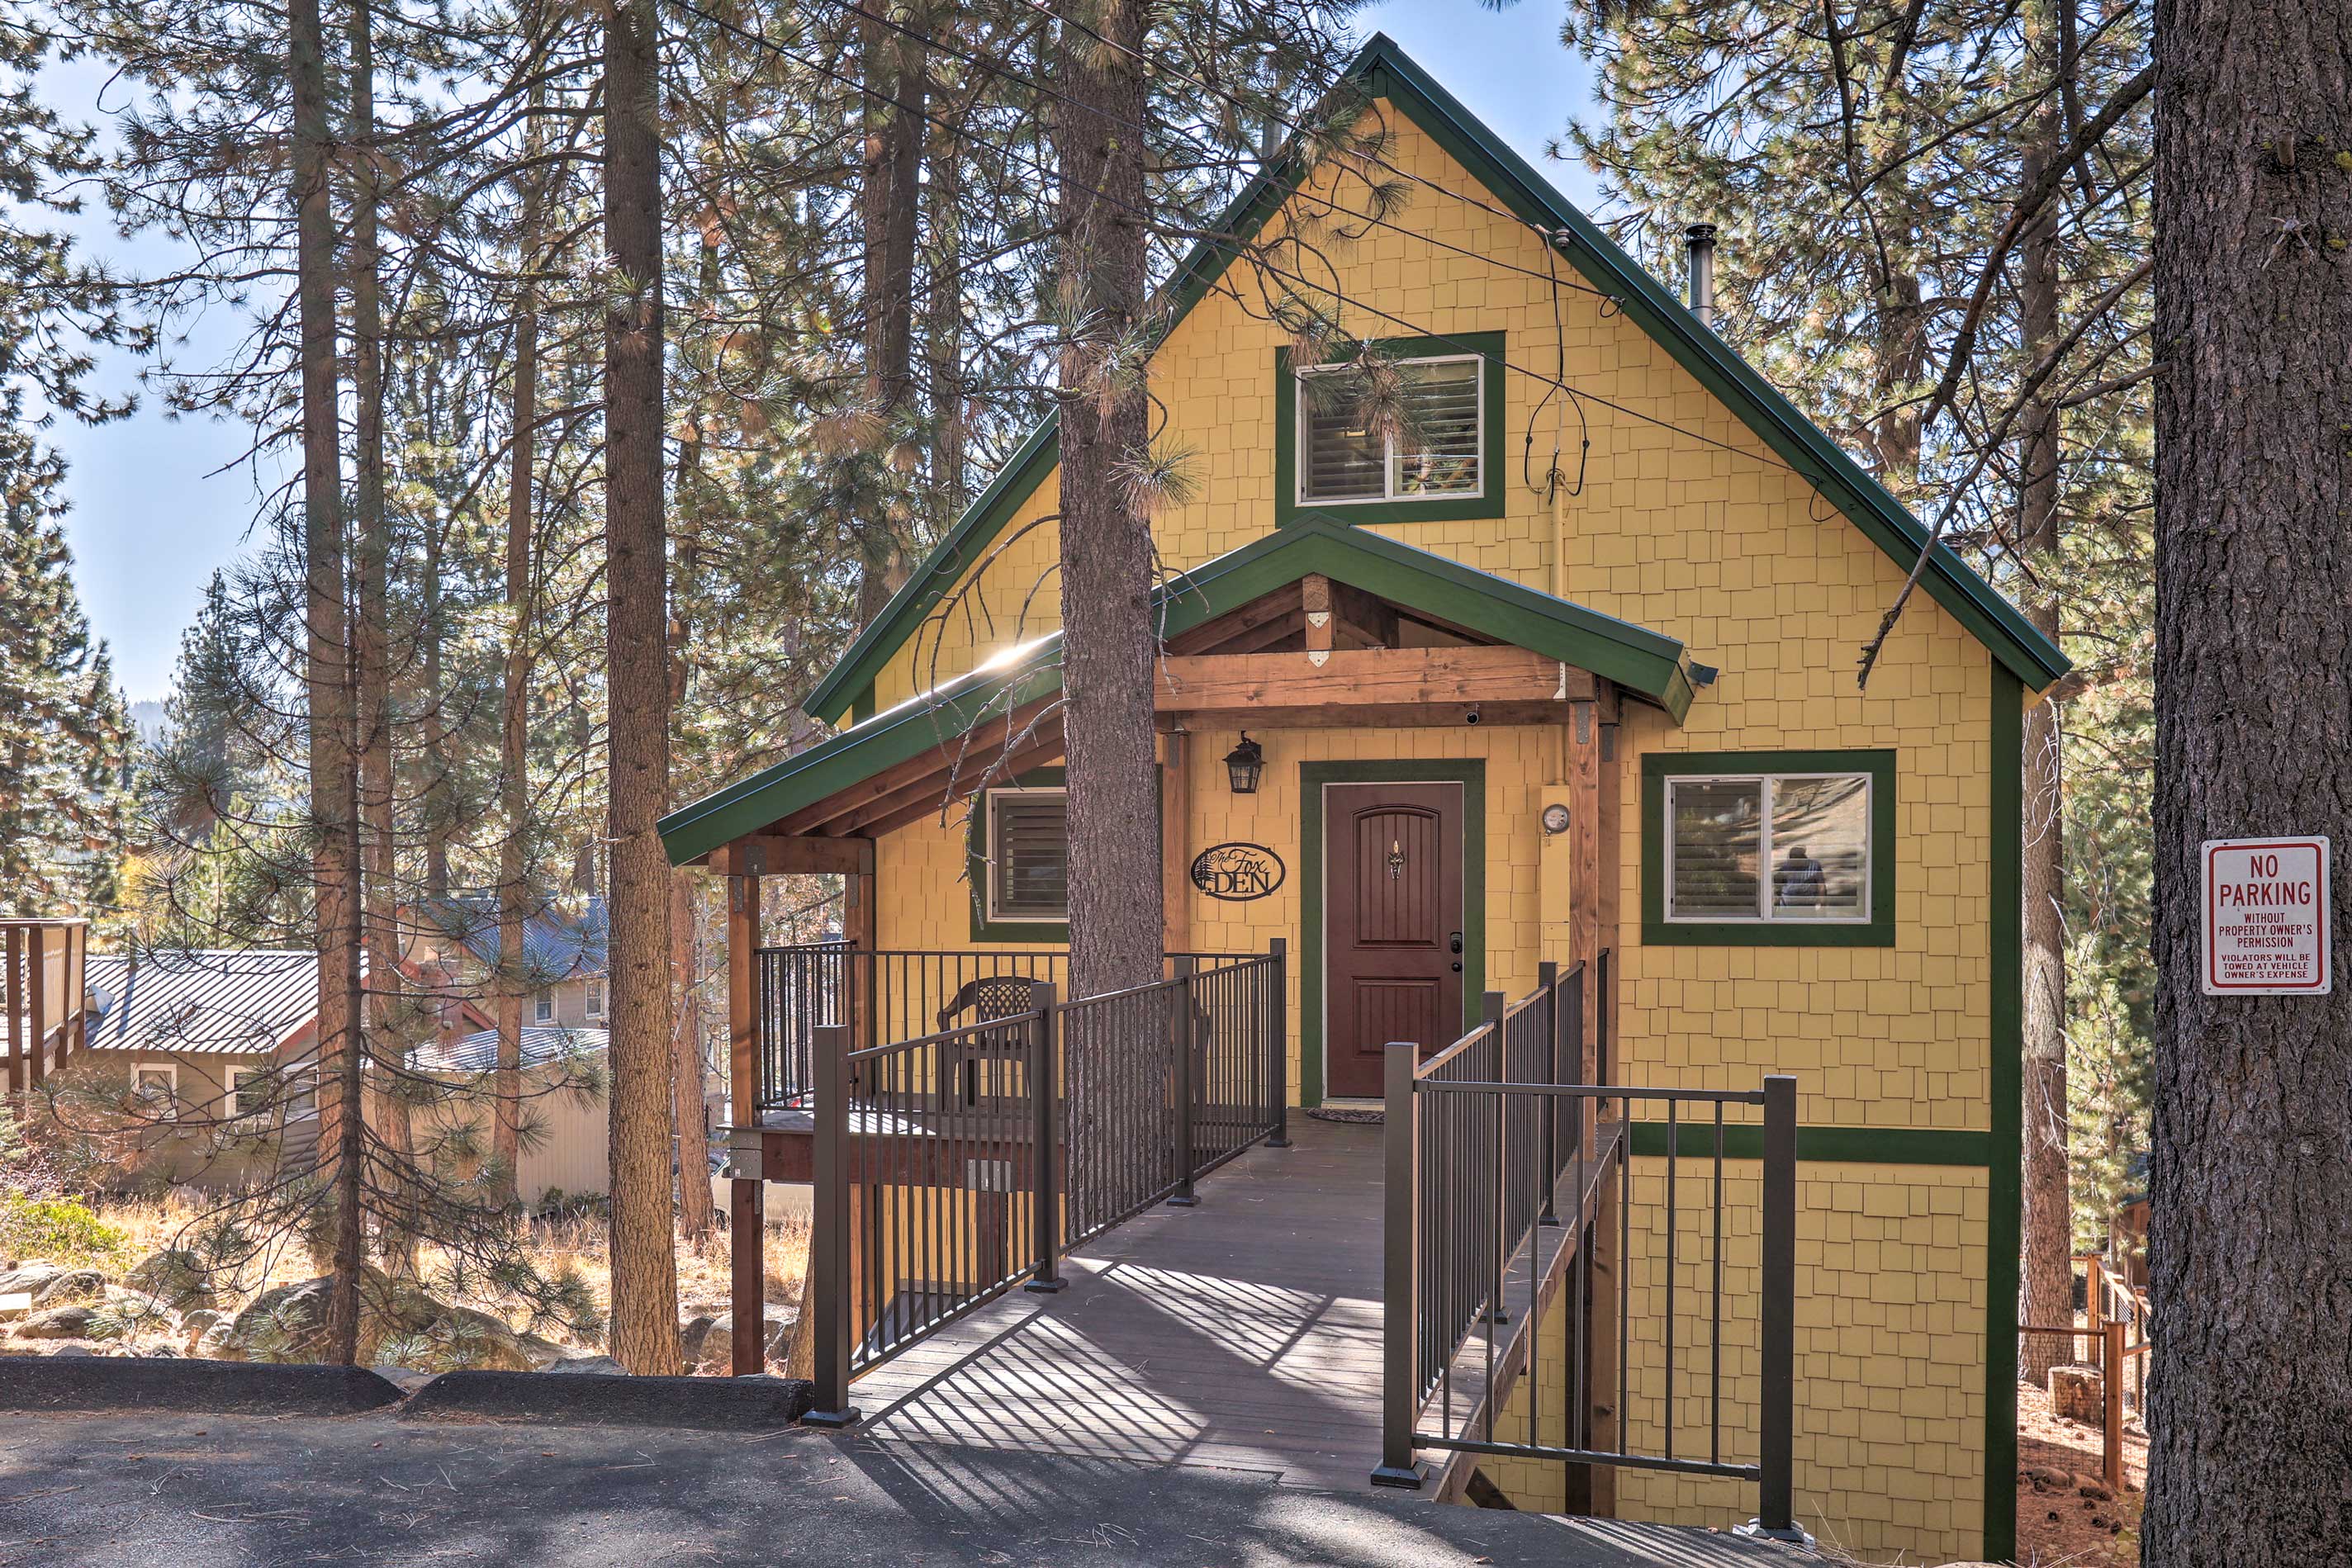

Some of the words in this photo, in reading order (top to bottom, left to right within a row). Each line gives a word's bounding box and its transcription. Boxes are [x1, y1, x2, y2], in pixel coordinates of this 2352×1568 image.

[1210, 850, 1230, 864] The
[1221, 849, 1267, 874] Fox
[2251, 855, 2278, 878] NO
[1213, 872, 1270, 893] DEN
[2220, 882, 2311, 907] PARKING
[2245, 913, 2285, 923] WITHOUT
[2219, 926, 2266, 936] PROPERTY
[2270, 925, 2312, 935] OWNER'S
[2237, 937, 2293, 948] PERMISSION
